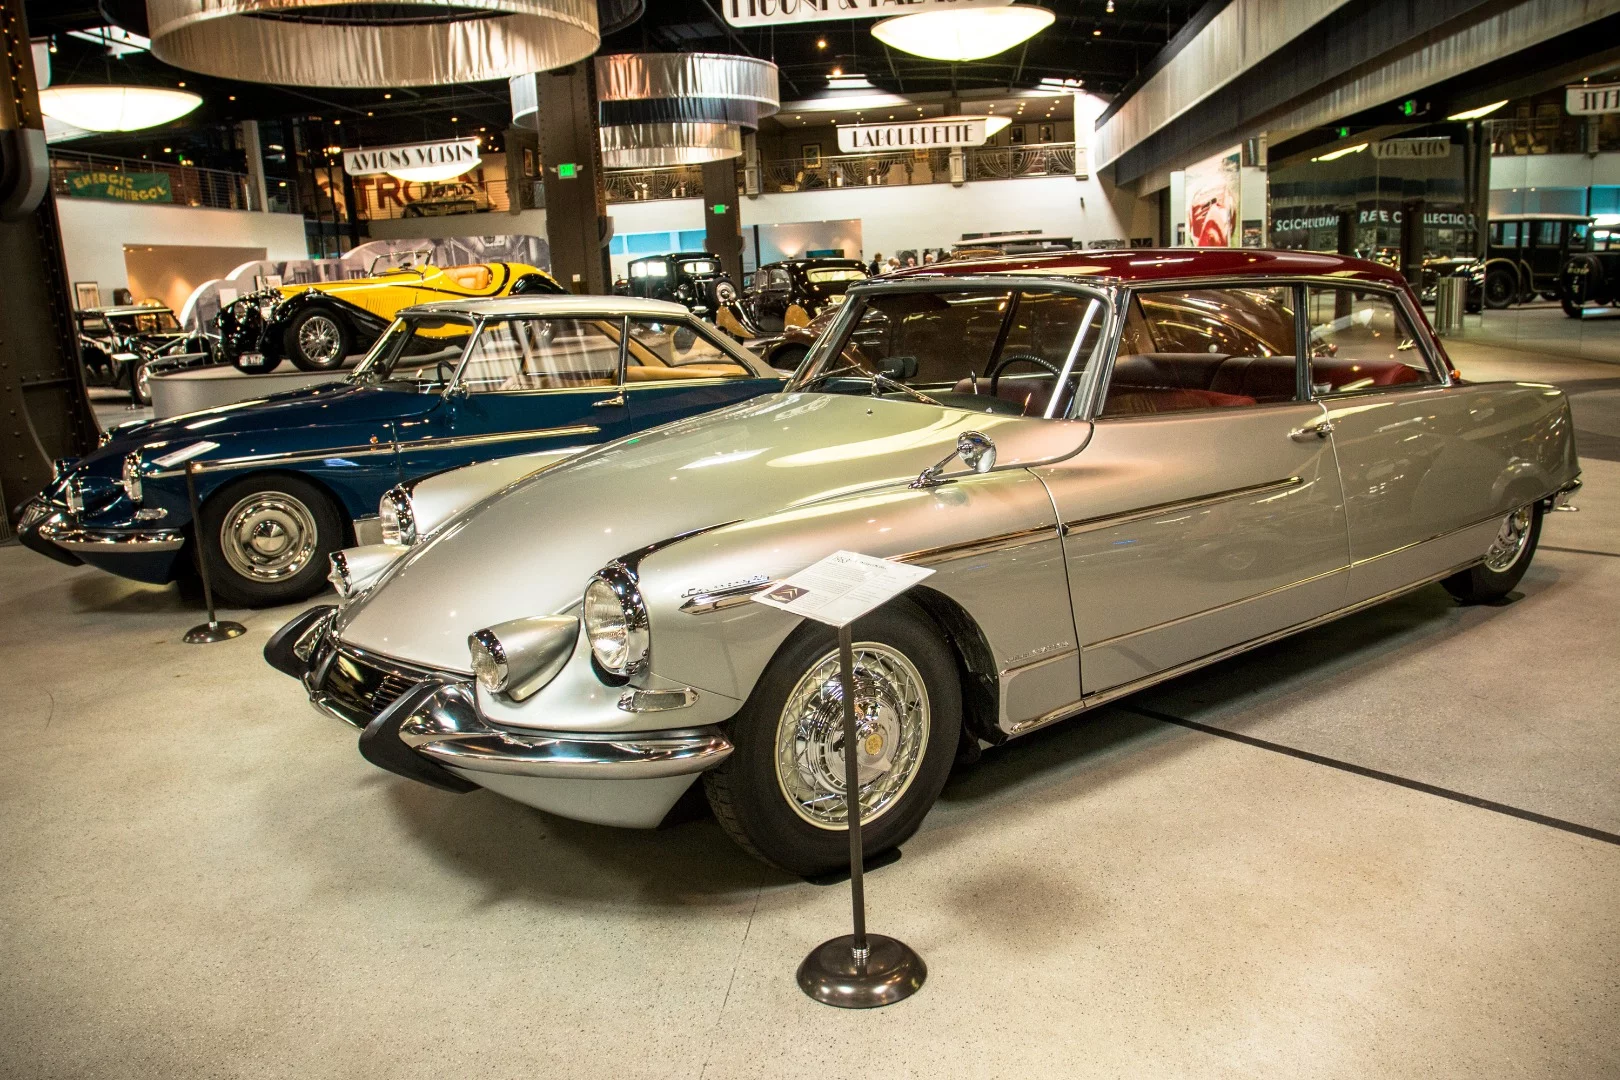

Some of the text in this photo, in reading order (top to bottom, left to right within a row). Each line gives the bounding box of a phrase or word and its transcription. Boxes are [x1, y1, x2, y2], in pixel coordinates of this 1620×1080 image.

[852, 123, 974, 148] LABOURDETTE
[350, 144, 474, 171] AVIONS VOISIN
